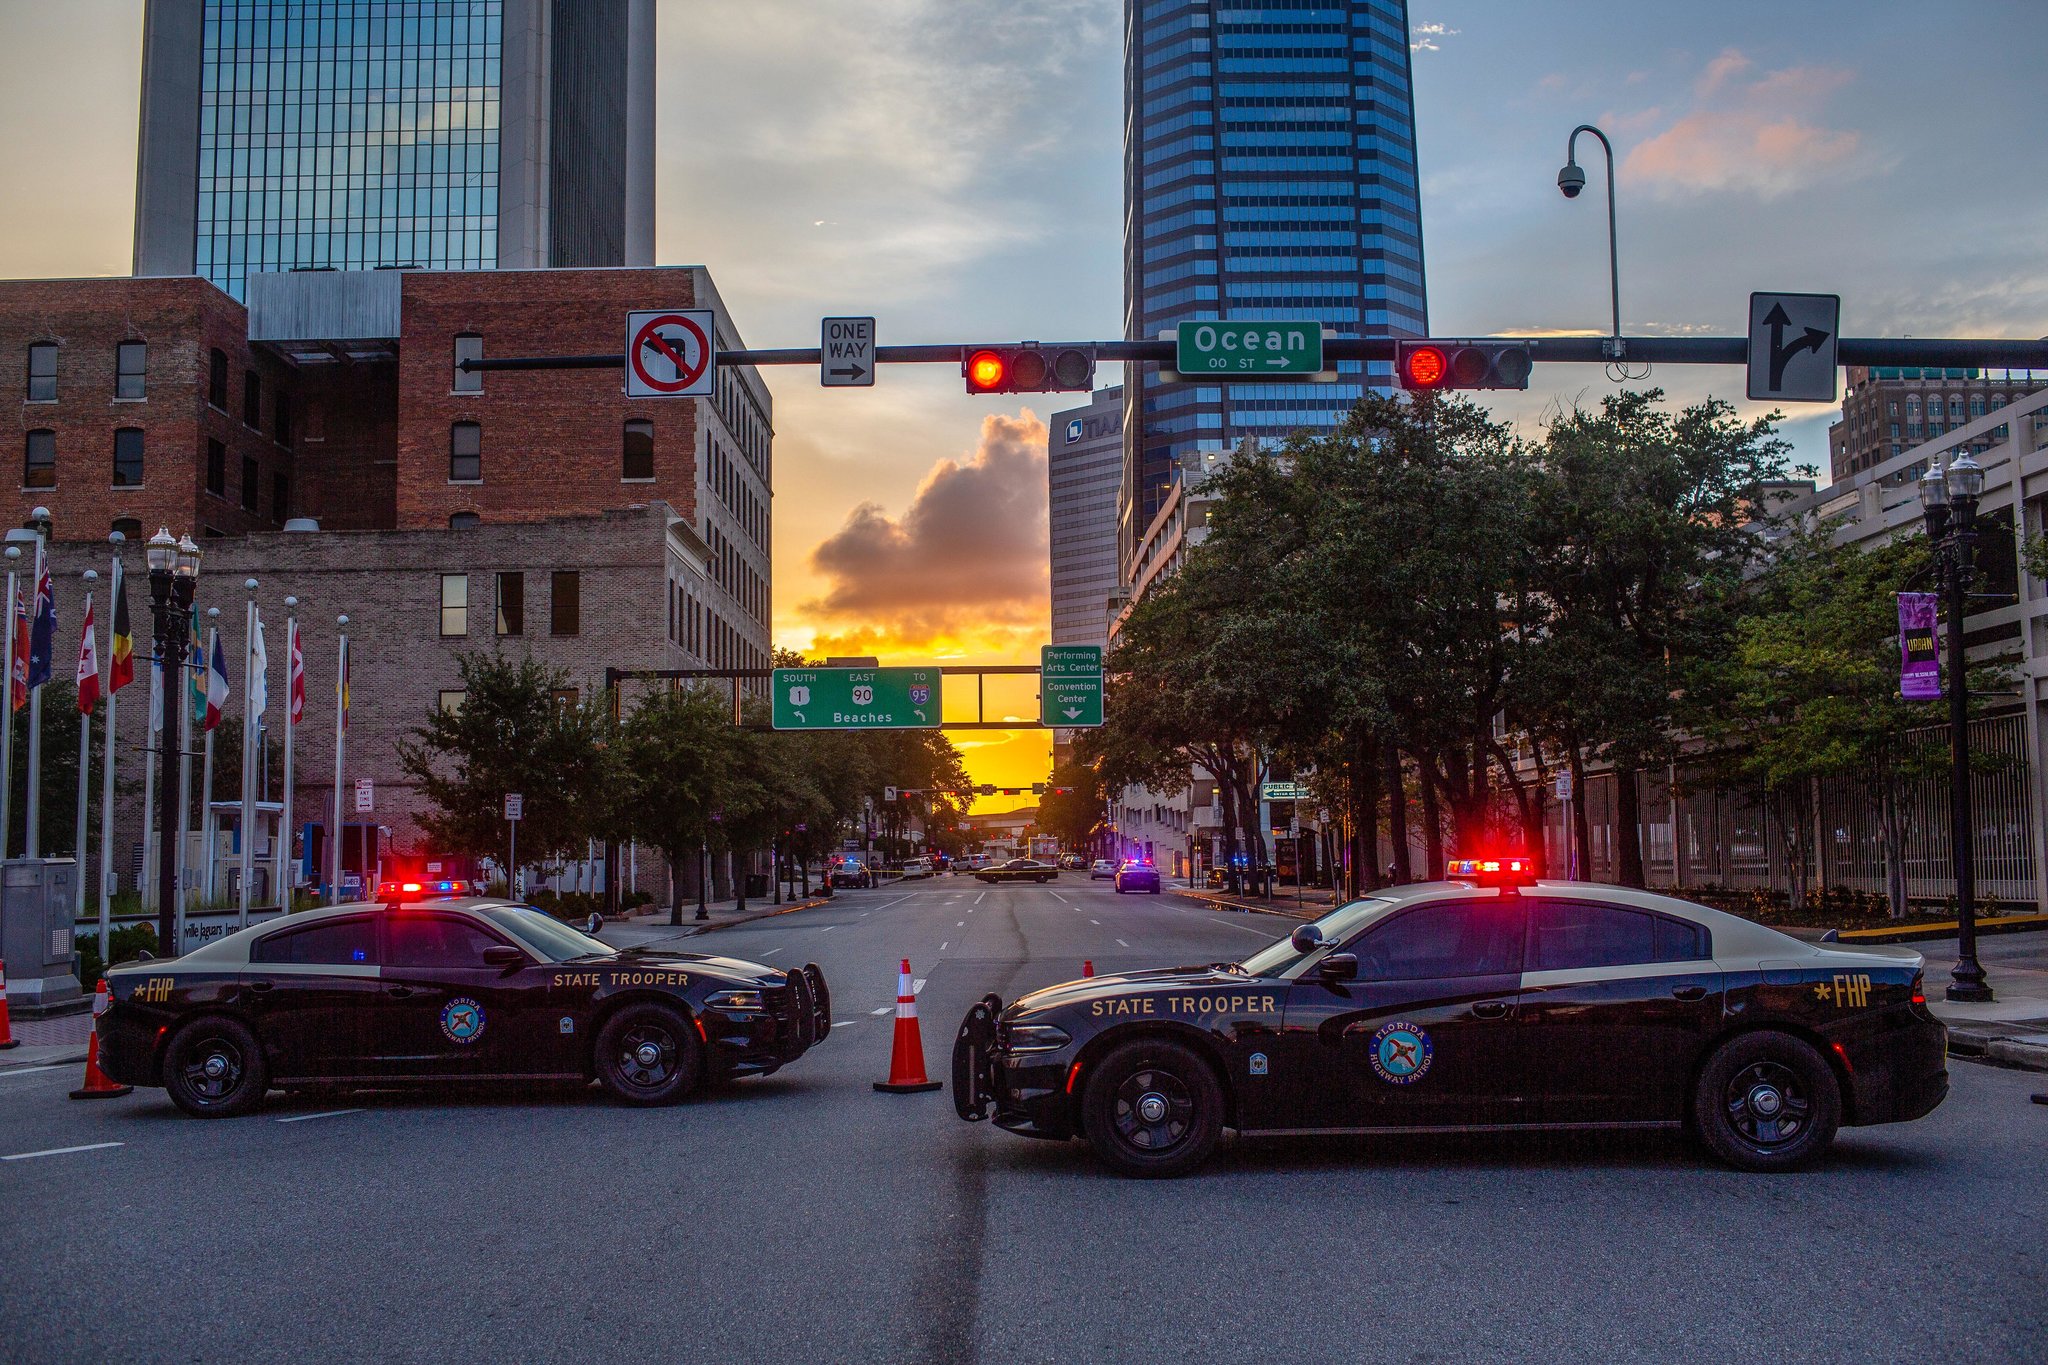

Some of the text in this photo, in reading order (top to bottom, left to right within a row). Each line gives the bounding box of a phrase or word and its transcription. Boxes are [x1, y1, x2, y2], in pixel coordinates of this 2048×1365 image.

[830, 323, 867, 339] ONE
[1194, 325, 1305, 352] Ocean
[829, 342, 867, 358] WAY
[1239, 358, 1255, 368] ST
[1906, 636, 1933, 652] URBAN
[1047, 651, 1097, 662] Performing
[1046, 663, 1099, 672] Arts Center
[783, 673, 817, 683] SOUTH
[849, 673, 876, 682] EAST
[913, 673, 927, 681] TO
[1047, 682, 1097, 691] Convention
[796, 690, 802, 702] 1
[853, 689, 872, 702] 90
[912, 689, 928, 702] 95
[1057, 694, 1087, 703] Center
[833, 712, 893, 723] Beaches
[199, 922, 223, 941] Jaguars
[554, 972, 689, 987] STATE TROOPER
[444, 997, 481, 1012] FLORIDA
[1092, 995, 1276, 1016] STATE TROOPER
[440, 1020, 485, 1044] HIGHWAY PATROL
[1375, 1022, 1425, 1040] FLORIDA
[1370, 1053, 1433, 1084] HIGHWAY PATROL
